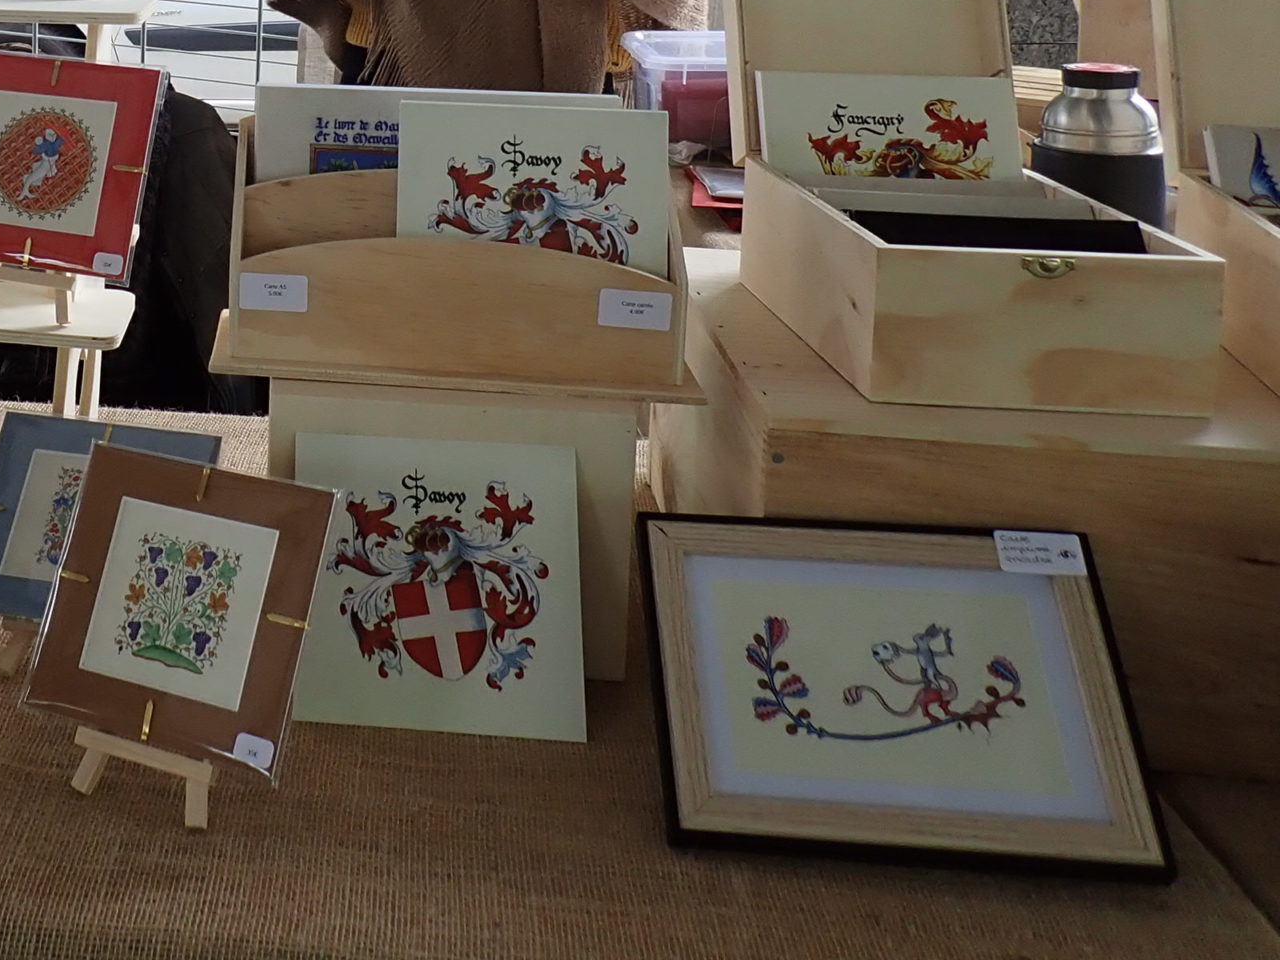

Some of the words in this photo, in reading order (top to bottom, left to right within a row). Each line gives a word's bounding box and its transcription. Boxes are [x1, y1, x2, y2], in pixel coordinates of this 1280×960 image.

[827, 103, 905, 138] Faucigny
[500, 134, 563, 179] Savoy
[401, 467, 467, 516] Savoy
